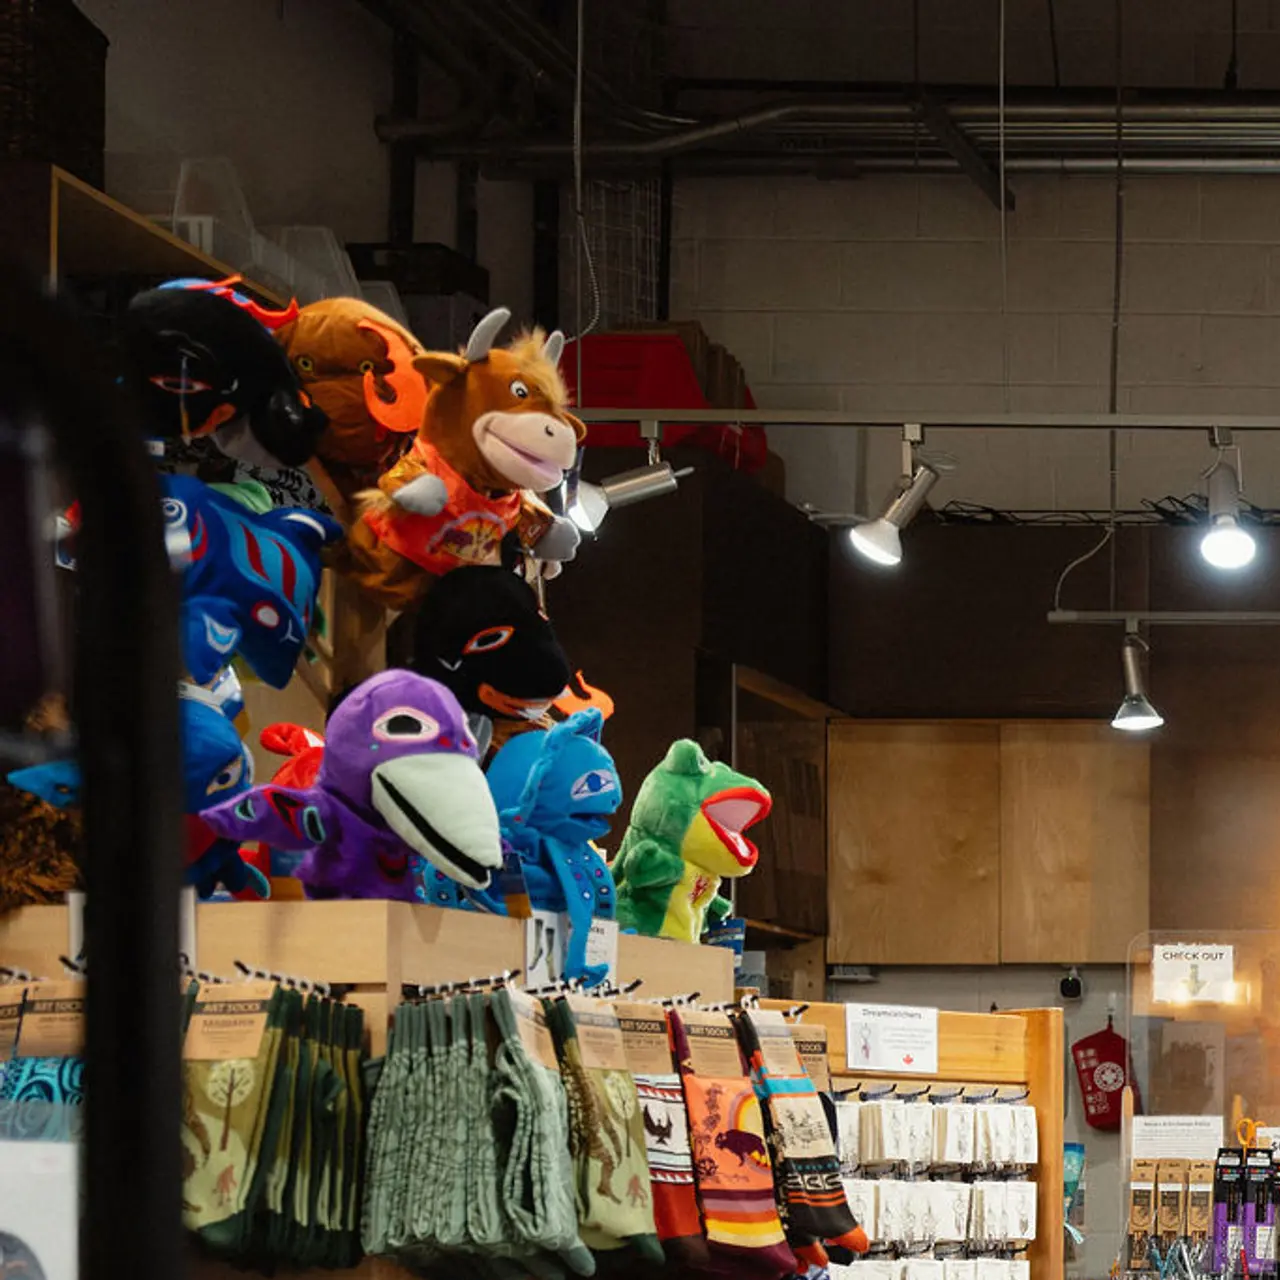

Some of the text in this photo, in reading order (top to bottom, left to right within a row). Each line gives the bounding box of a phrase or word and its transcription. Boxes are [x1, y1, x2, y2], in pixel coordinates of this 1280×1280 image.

[1162, 951, 1225, 961] CHECK OUT
[620, 1019, 634, 1031] ART
[635, 1021, 661, 1032] SOCKS
[705, 1026, 729, 1037] SOCKS
